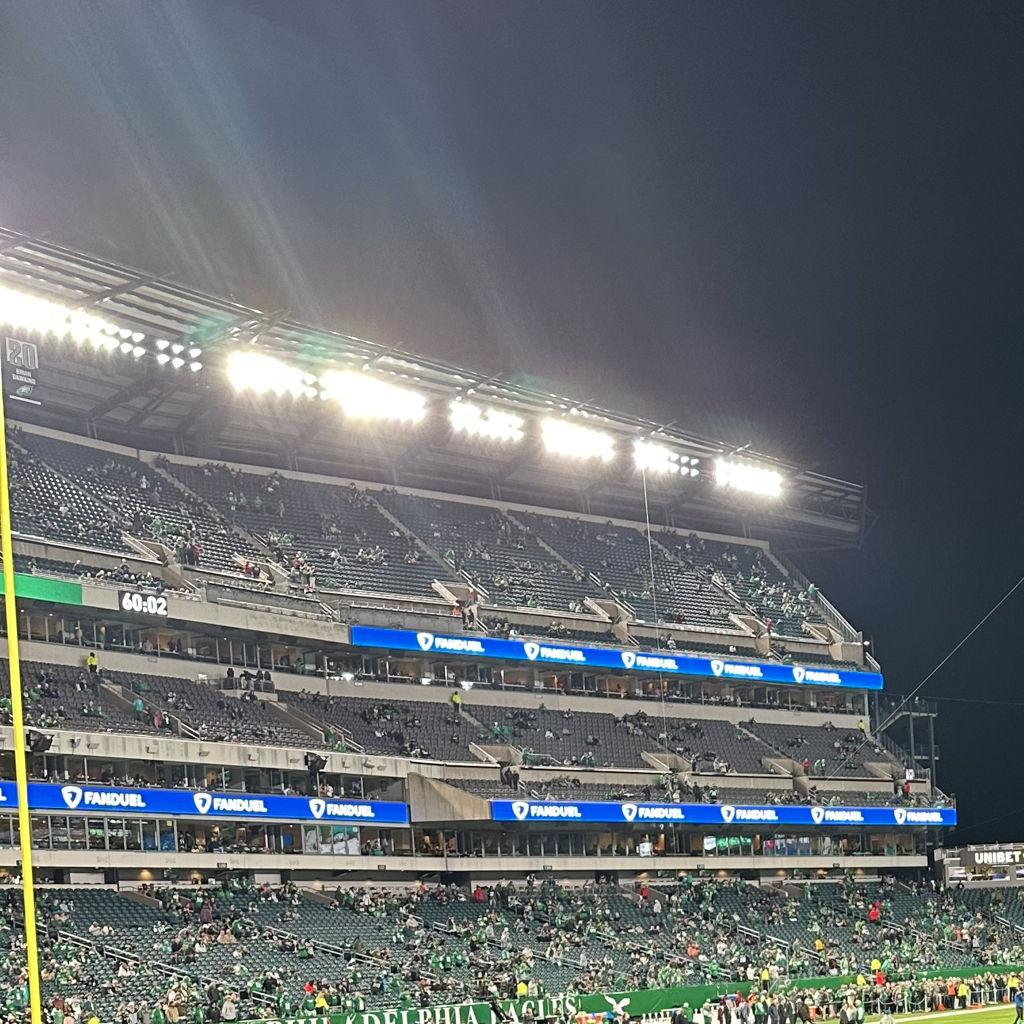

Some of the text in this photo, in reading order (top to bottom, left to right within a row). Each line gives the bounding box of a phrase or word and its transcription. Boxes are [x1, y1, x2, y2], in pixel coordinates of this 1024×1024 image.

[122, 592, 167, 616] 60:02
[84, 791, 146, 807] FANDUEL
[213, 798, 267, 812] FANDUEL
[326, 804, 375, 818] FANDUEL
[530, 805, 581, 818] FANDUEL
[638, 808, 685, 819] FANDUEL
[736, 809, 778, 820] FANDUEL
[974, 850, 1022, 864] UNIBET
